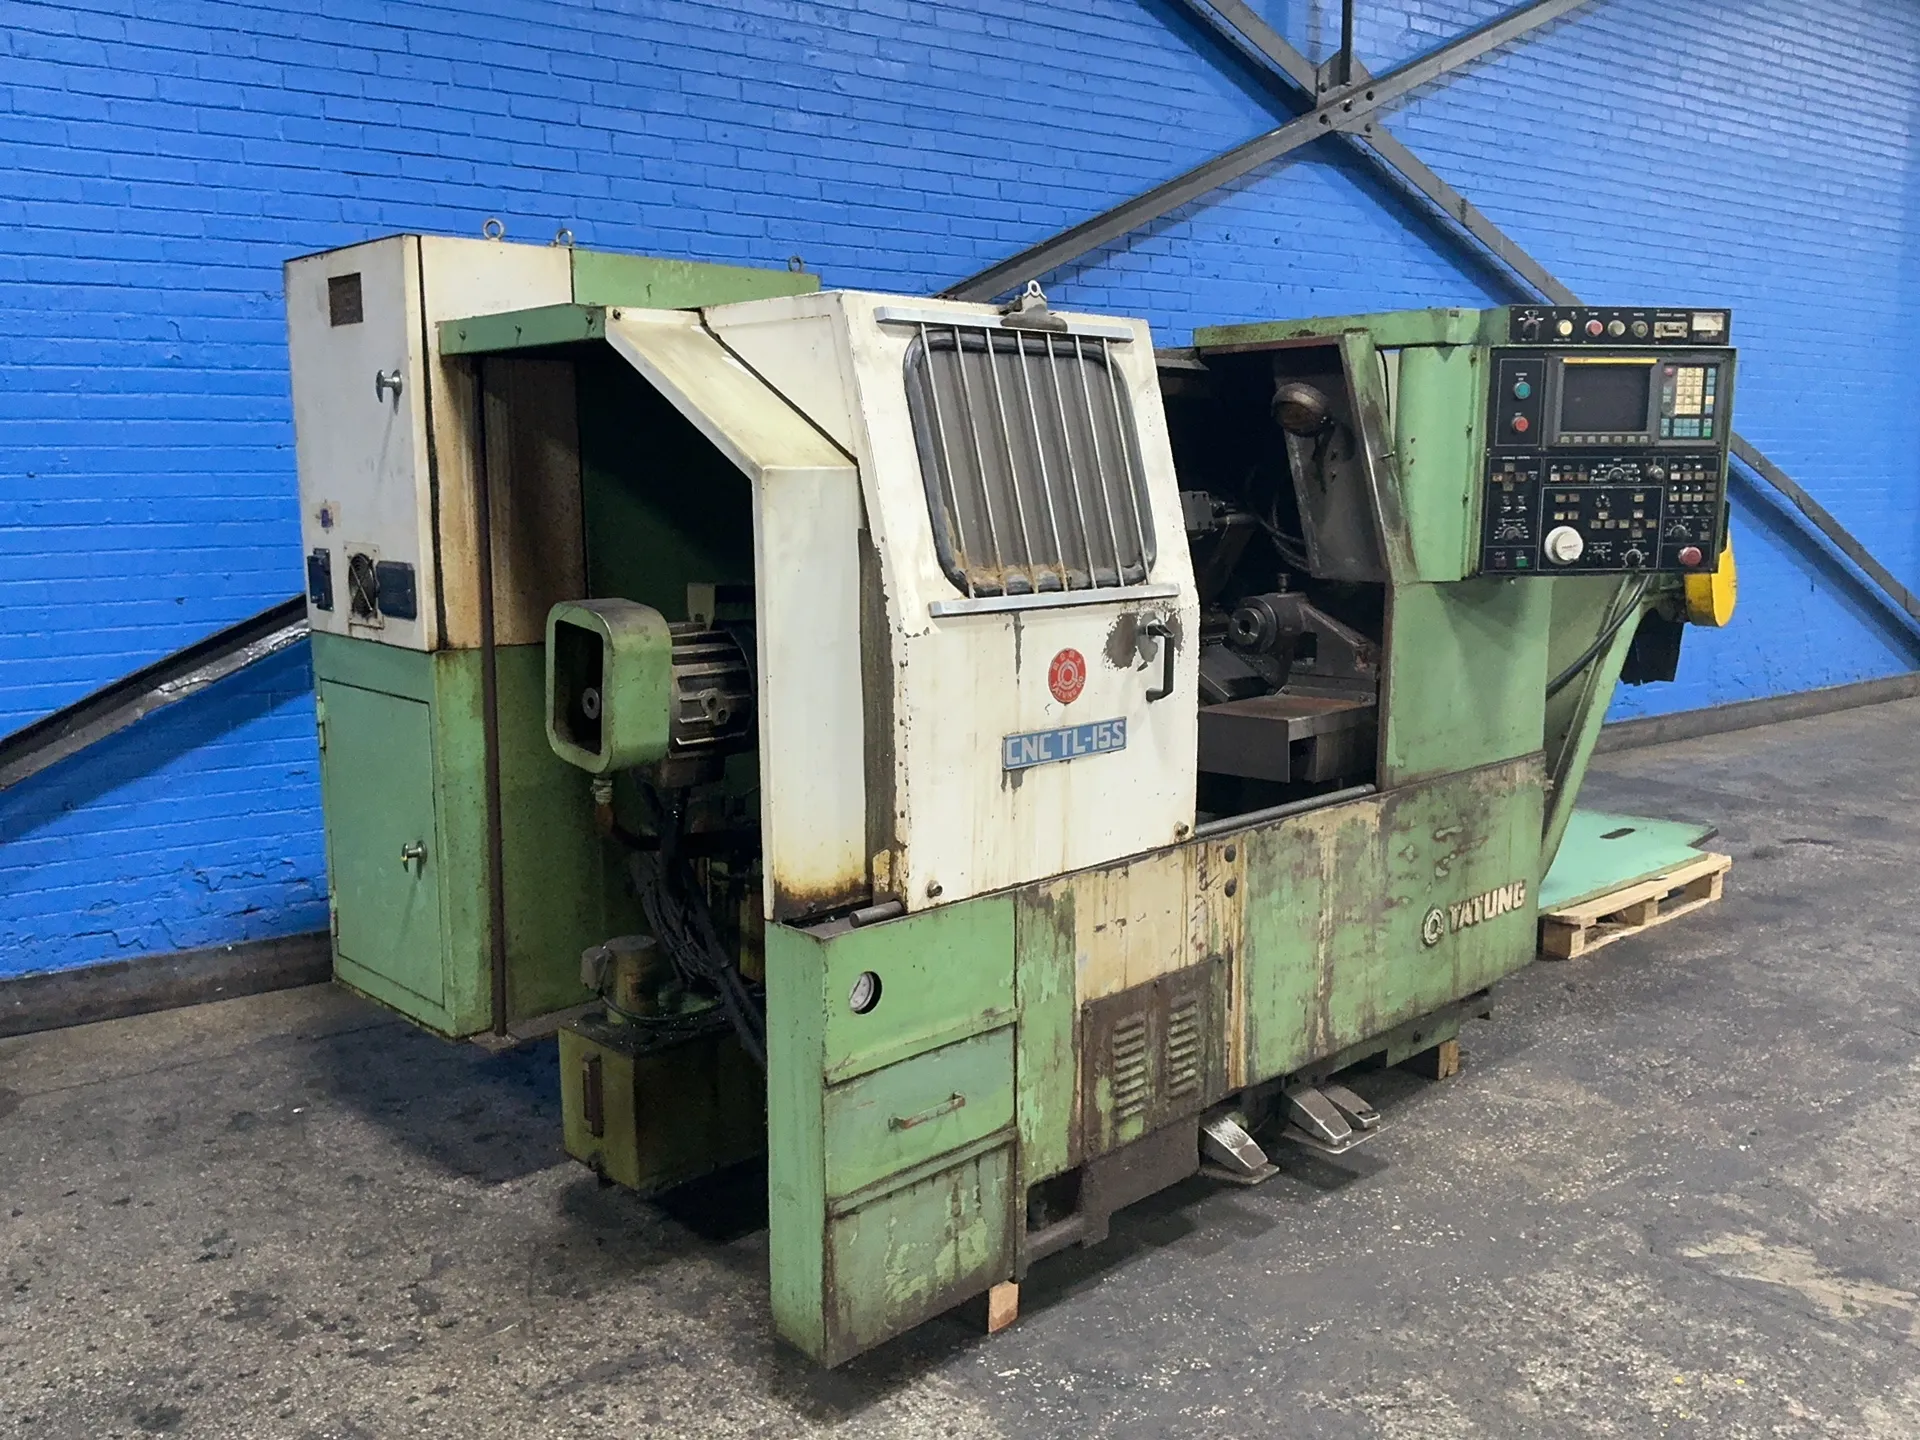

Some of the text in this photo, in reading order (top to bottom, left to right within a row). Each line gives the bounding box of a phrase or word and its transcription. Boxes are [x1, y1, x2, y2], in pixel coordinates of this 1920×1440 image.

[1006, 721, 1125, 765] CNC TL-15S
[1449, 881, 1526, 933] TATUNG
